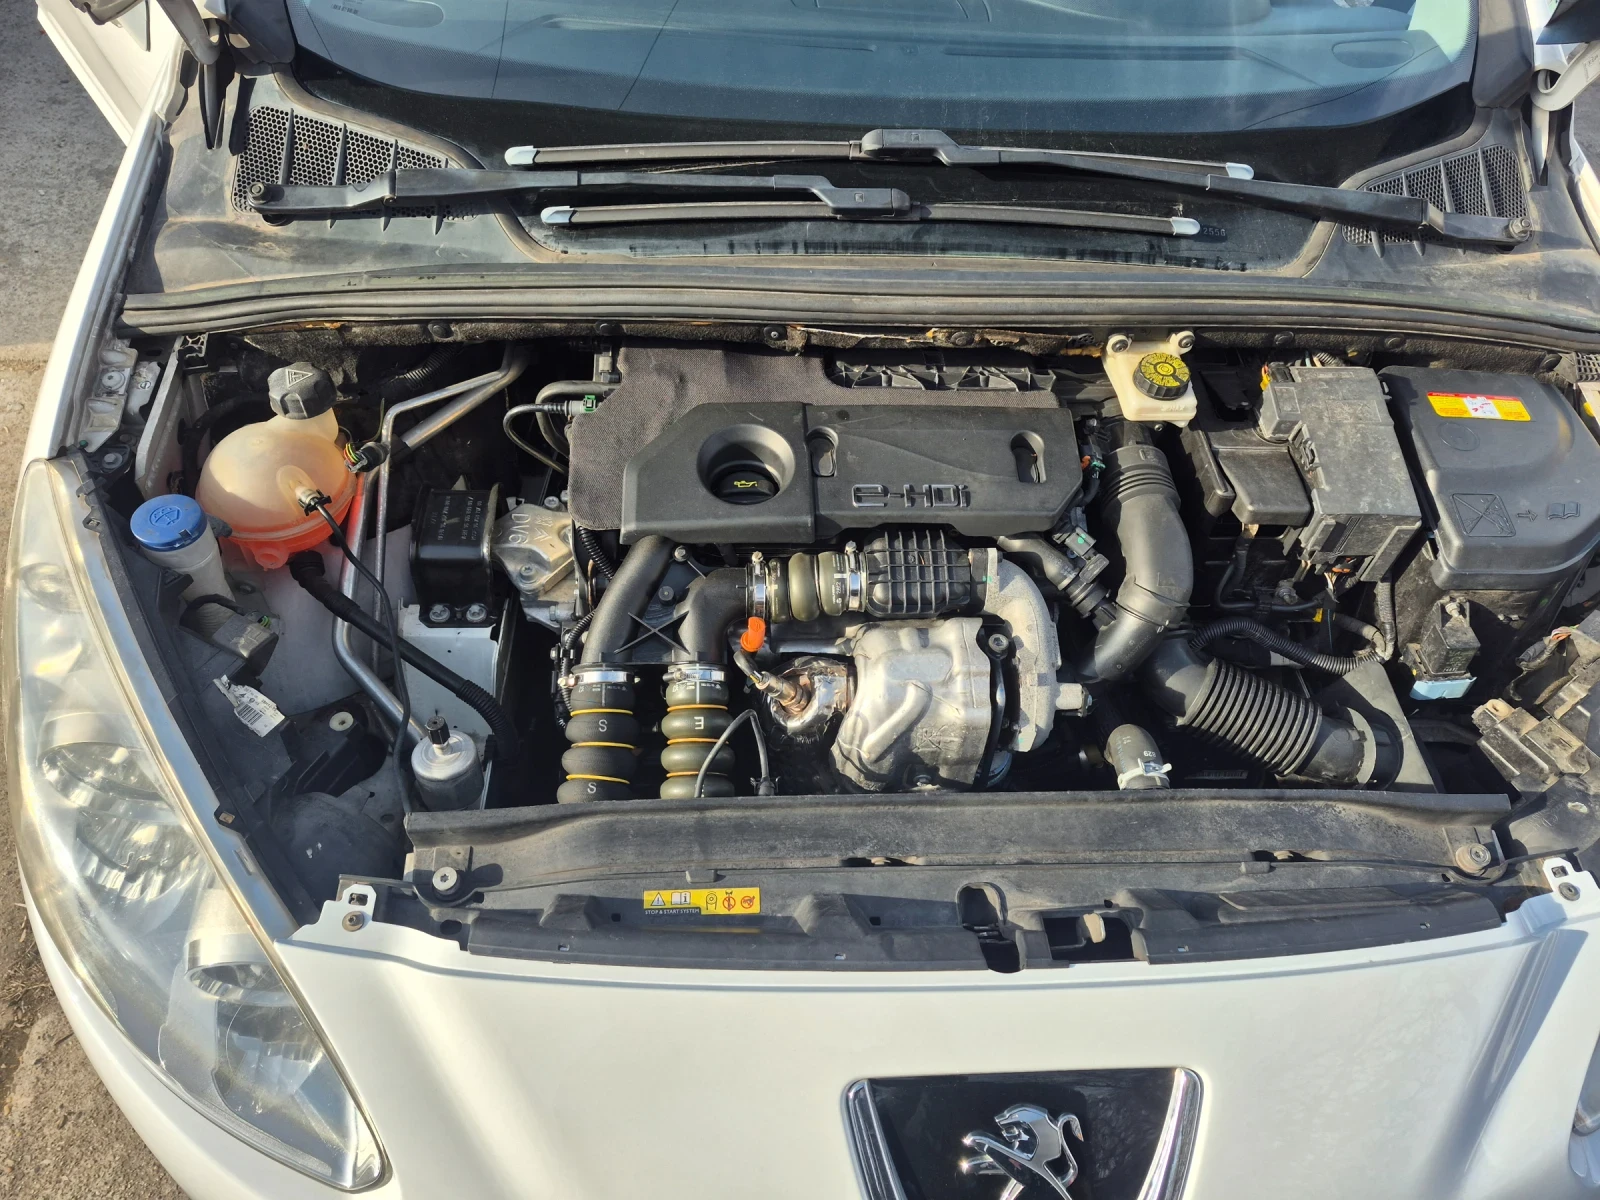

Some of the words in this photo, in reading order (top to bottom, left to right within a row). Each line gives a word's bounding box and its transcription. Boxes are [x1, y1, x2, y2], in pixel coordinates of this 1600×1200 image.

[508, 513, 531, 544] DV6
[598, 719, 608, 733] S
[587, 782, 597, 794] S
